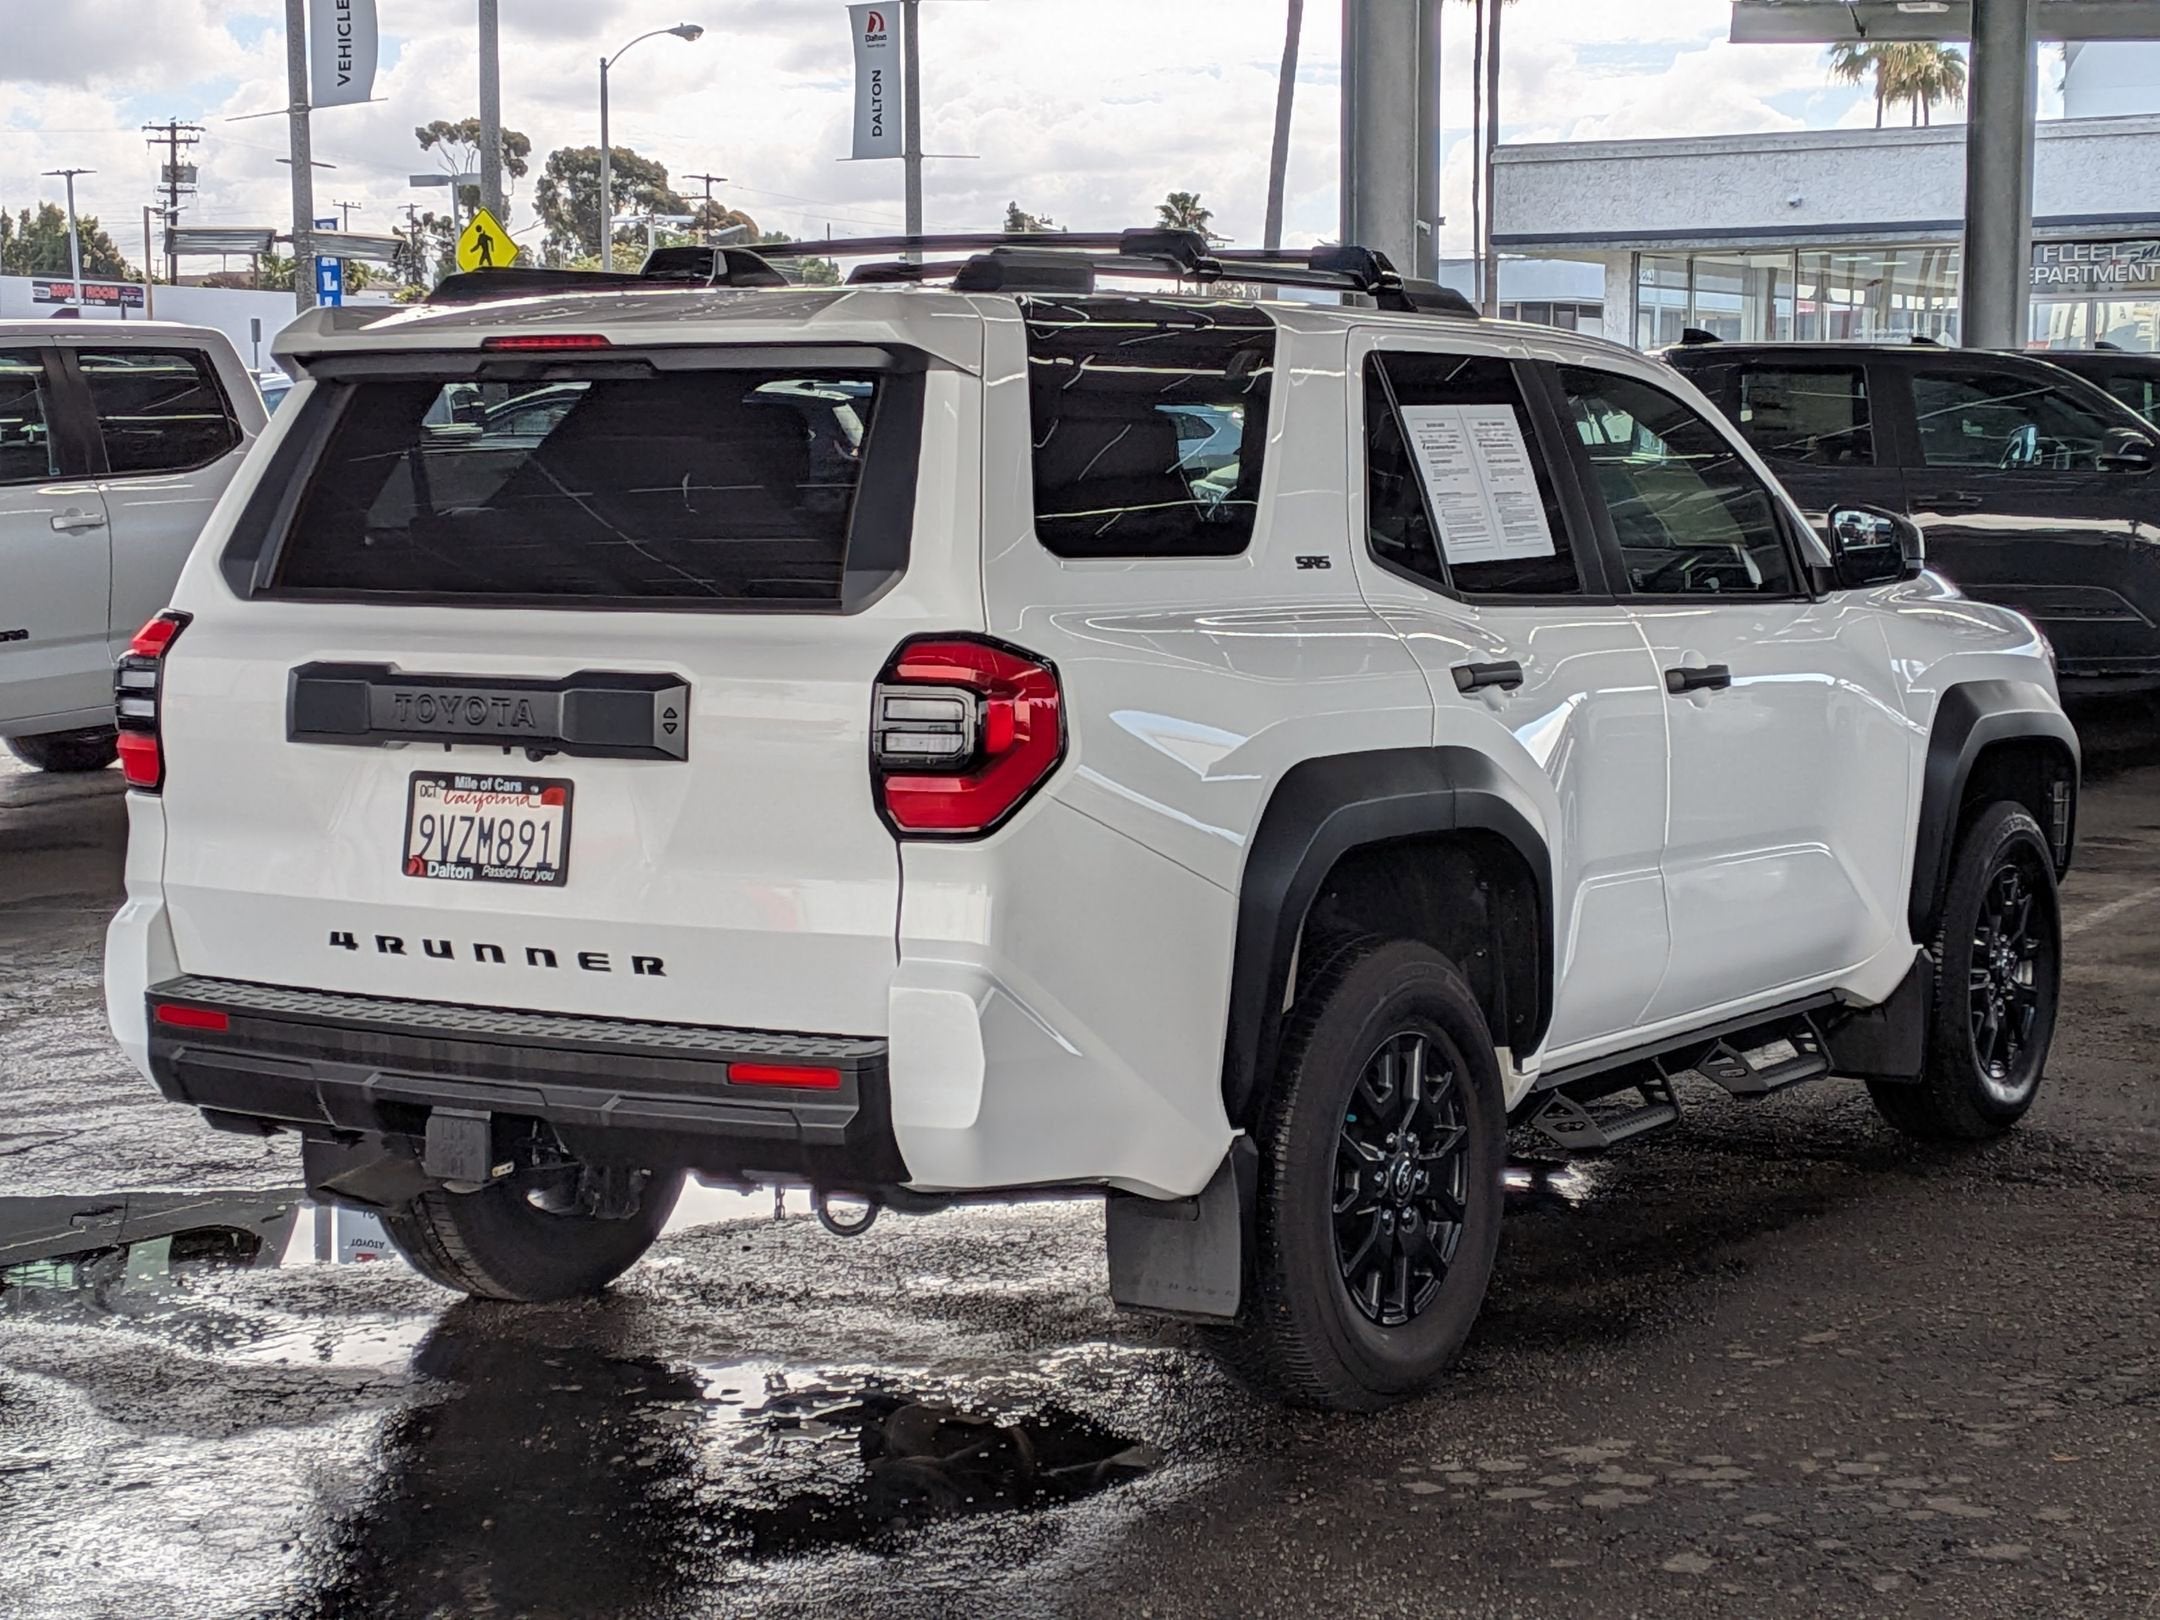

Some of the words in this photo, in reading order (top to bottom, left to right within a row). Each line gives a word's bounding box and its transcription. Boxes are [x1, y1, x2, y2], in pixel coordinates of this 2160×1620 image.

[871, 69, 883, 137] DALTON
[2042, 243, 2123, 263] FLEET
[1295, 555, 1332, 570] SR5
[394, 693, 536, 729] TOYOTA
[454, 776, 478, 790] Mile
[479, 777, 494, 789] of
[494, 779, 522, 793] Cars
[443, 790, 541, 813] California
[419, 814, 553, 869] 9VZM891
[427, 862, 475, 880] Dalton
[481, 864, 519, 879] Passion
[518, 867, 534, 881] for
[534, 869, 556, 883] you
[328, 931, 667, 977] 4RUNNER
